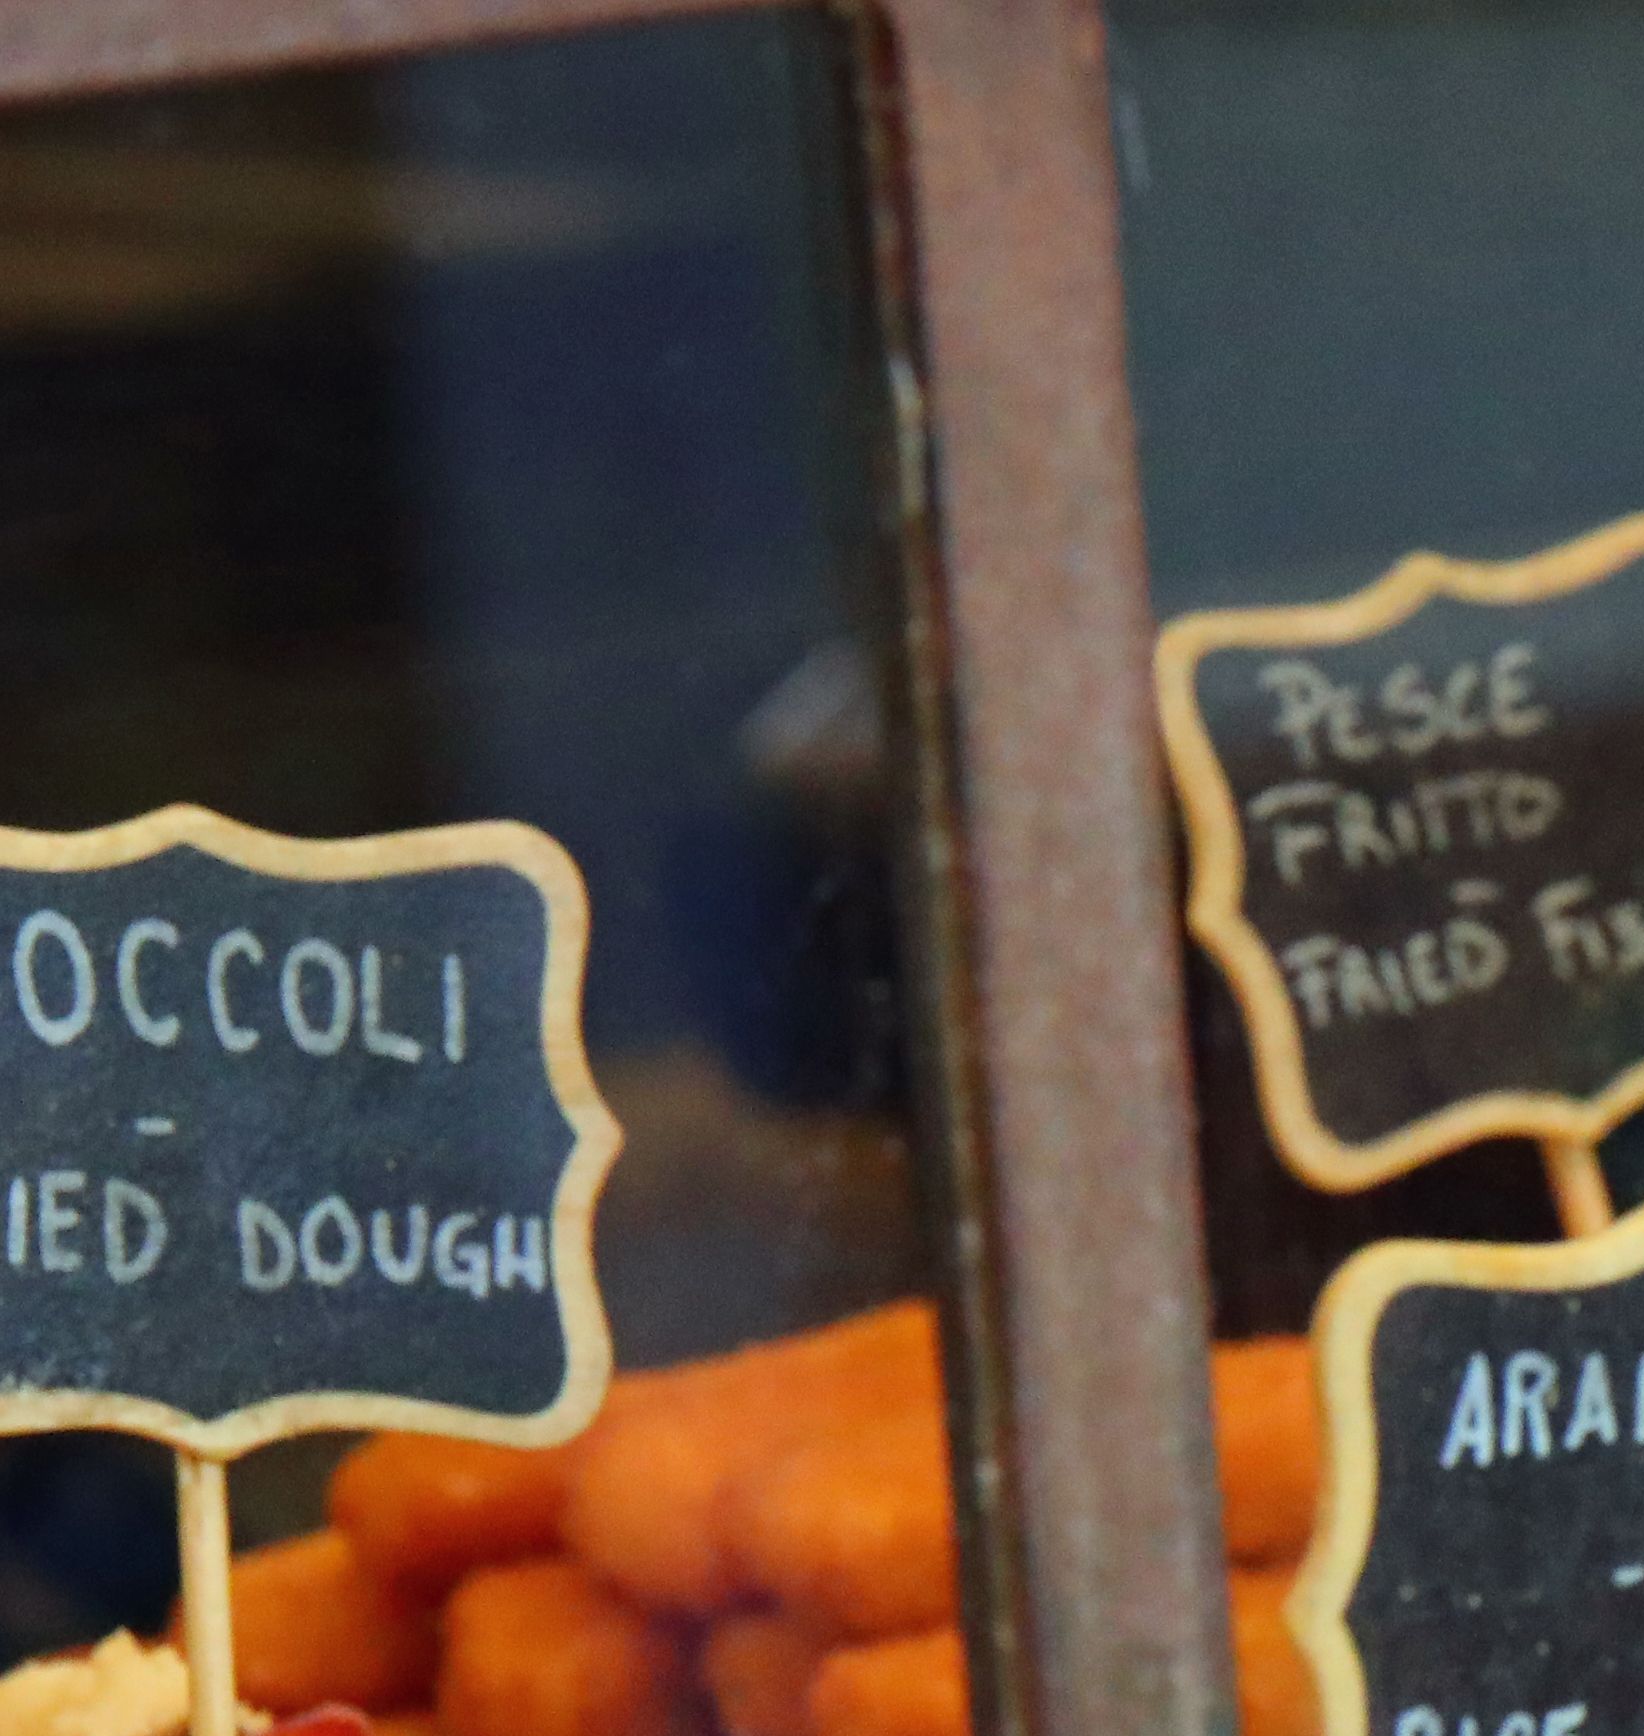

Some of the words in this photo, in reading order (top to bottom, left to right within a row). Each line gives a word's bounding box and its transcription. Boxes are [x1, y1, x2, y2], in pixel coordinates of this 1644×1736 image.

[1257, 640, 1551, 766] PESCE
[1248, 769, 1563, 887] FRITTO
[1280, 918, 1510, 1030] FRIED
[237, 1195, 551, 1300] DOUGH
